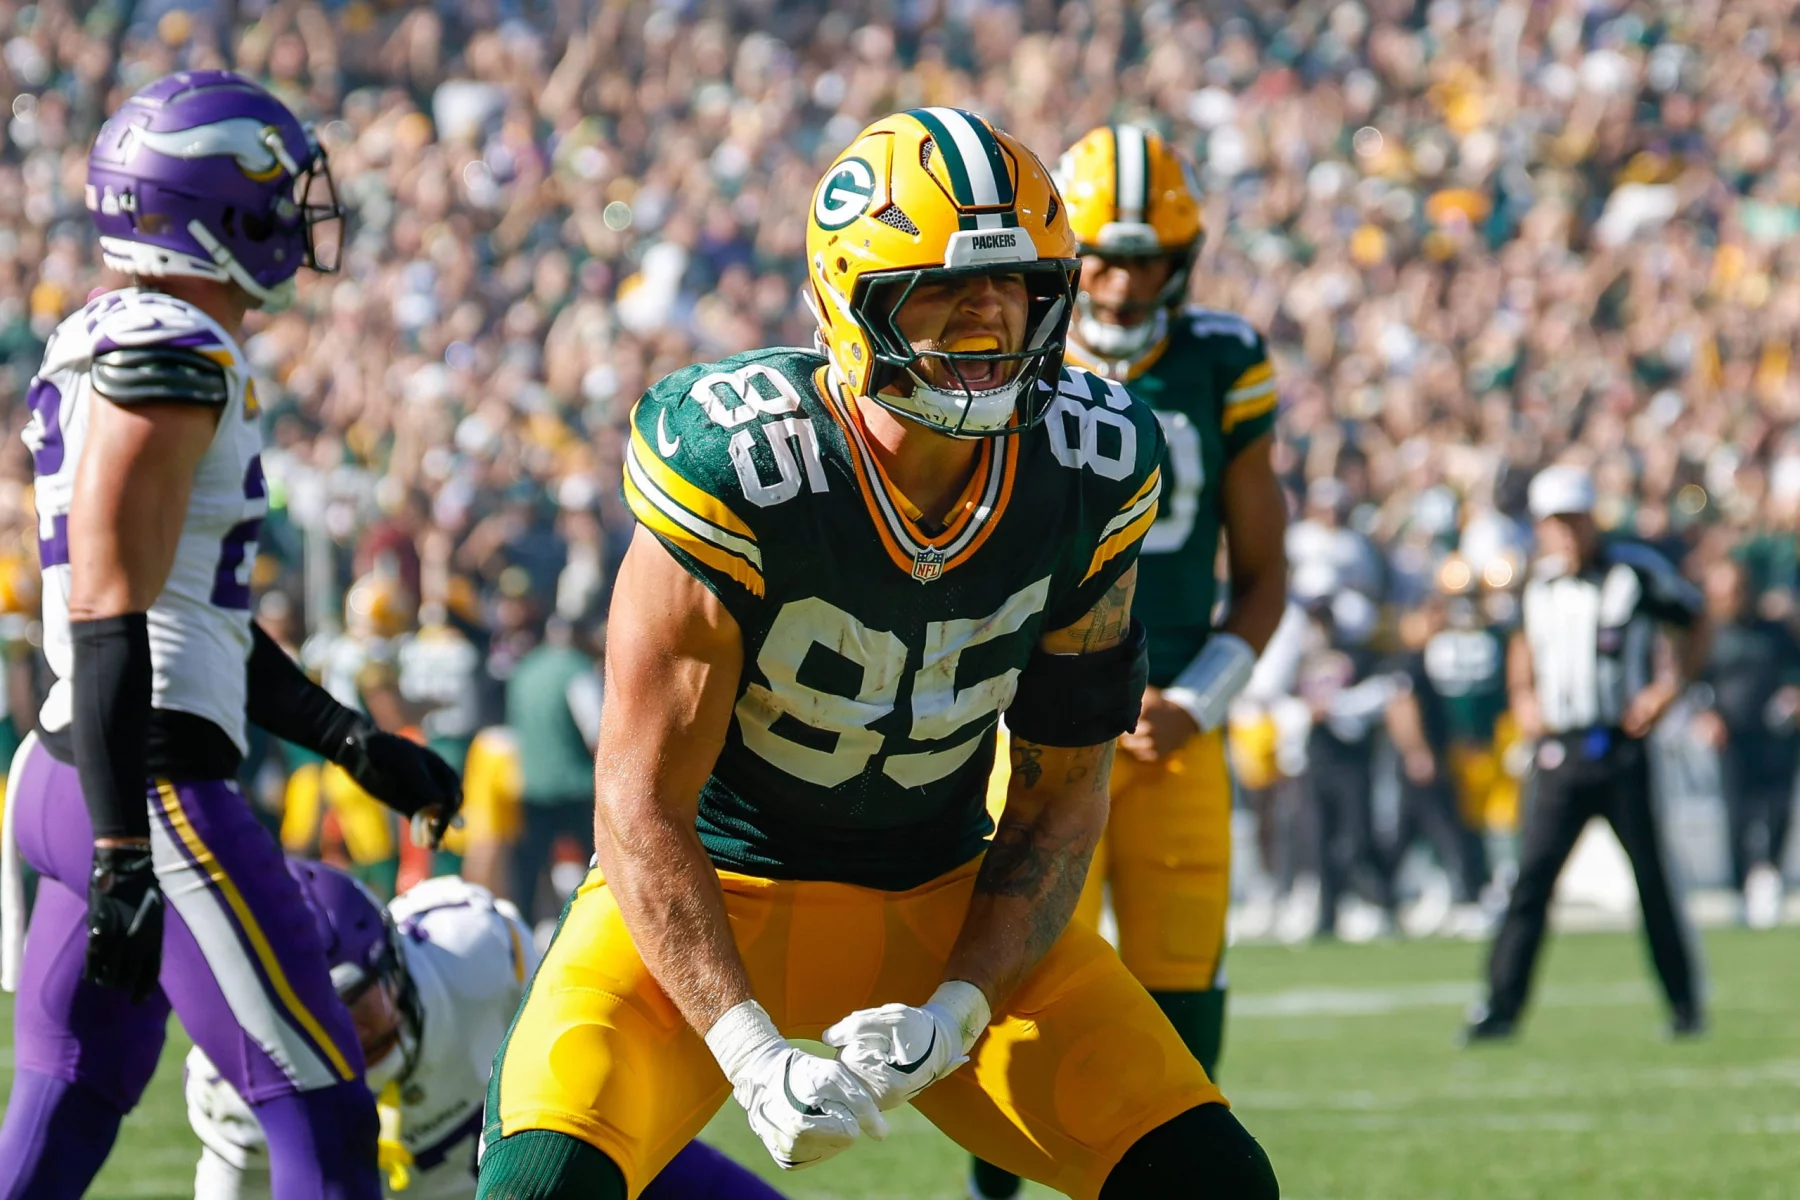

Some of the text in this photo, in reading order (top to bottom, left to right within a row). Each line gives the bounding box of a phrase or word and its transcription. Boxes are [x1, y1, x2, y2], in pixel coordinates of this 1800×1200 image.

[815, 157, 876, 231] G
[972, 234, 1016, 250] PACKERS
[690, 364, 829, 508] 85
[917, 563, 939, 578] NFL
[735, 574, 1052, 789] 85
